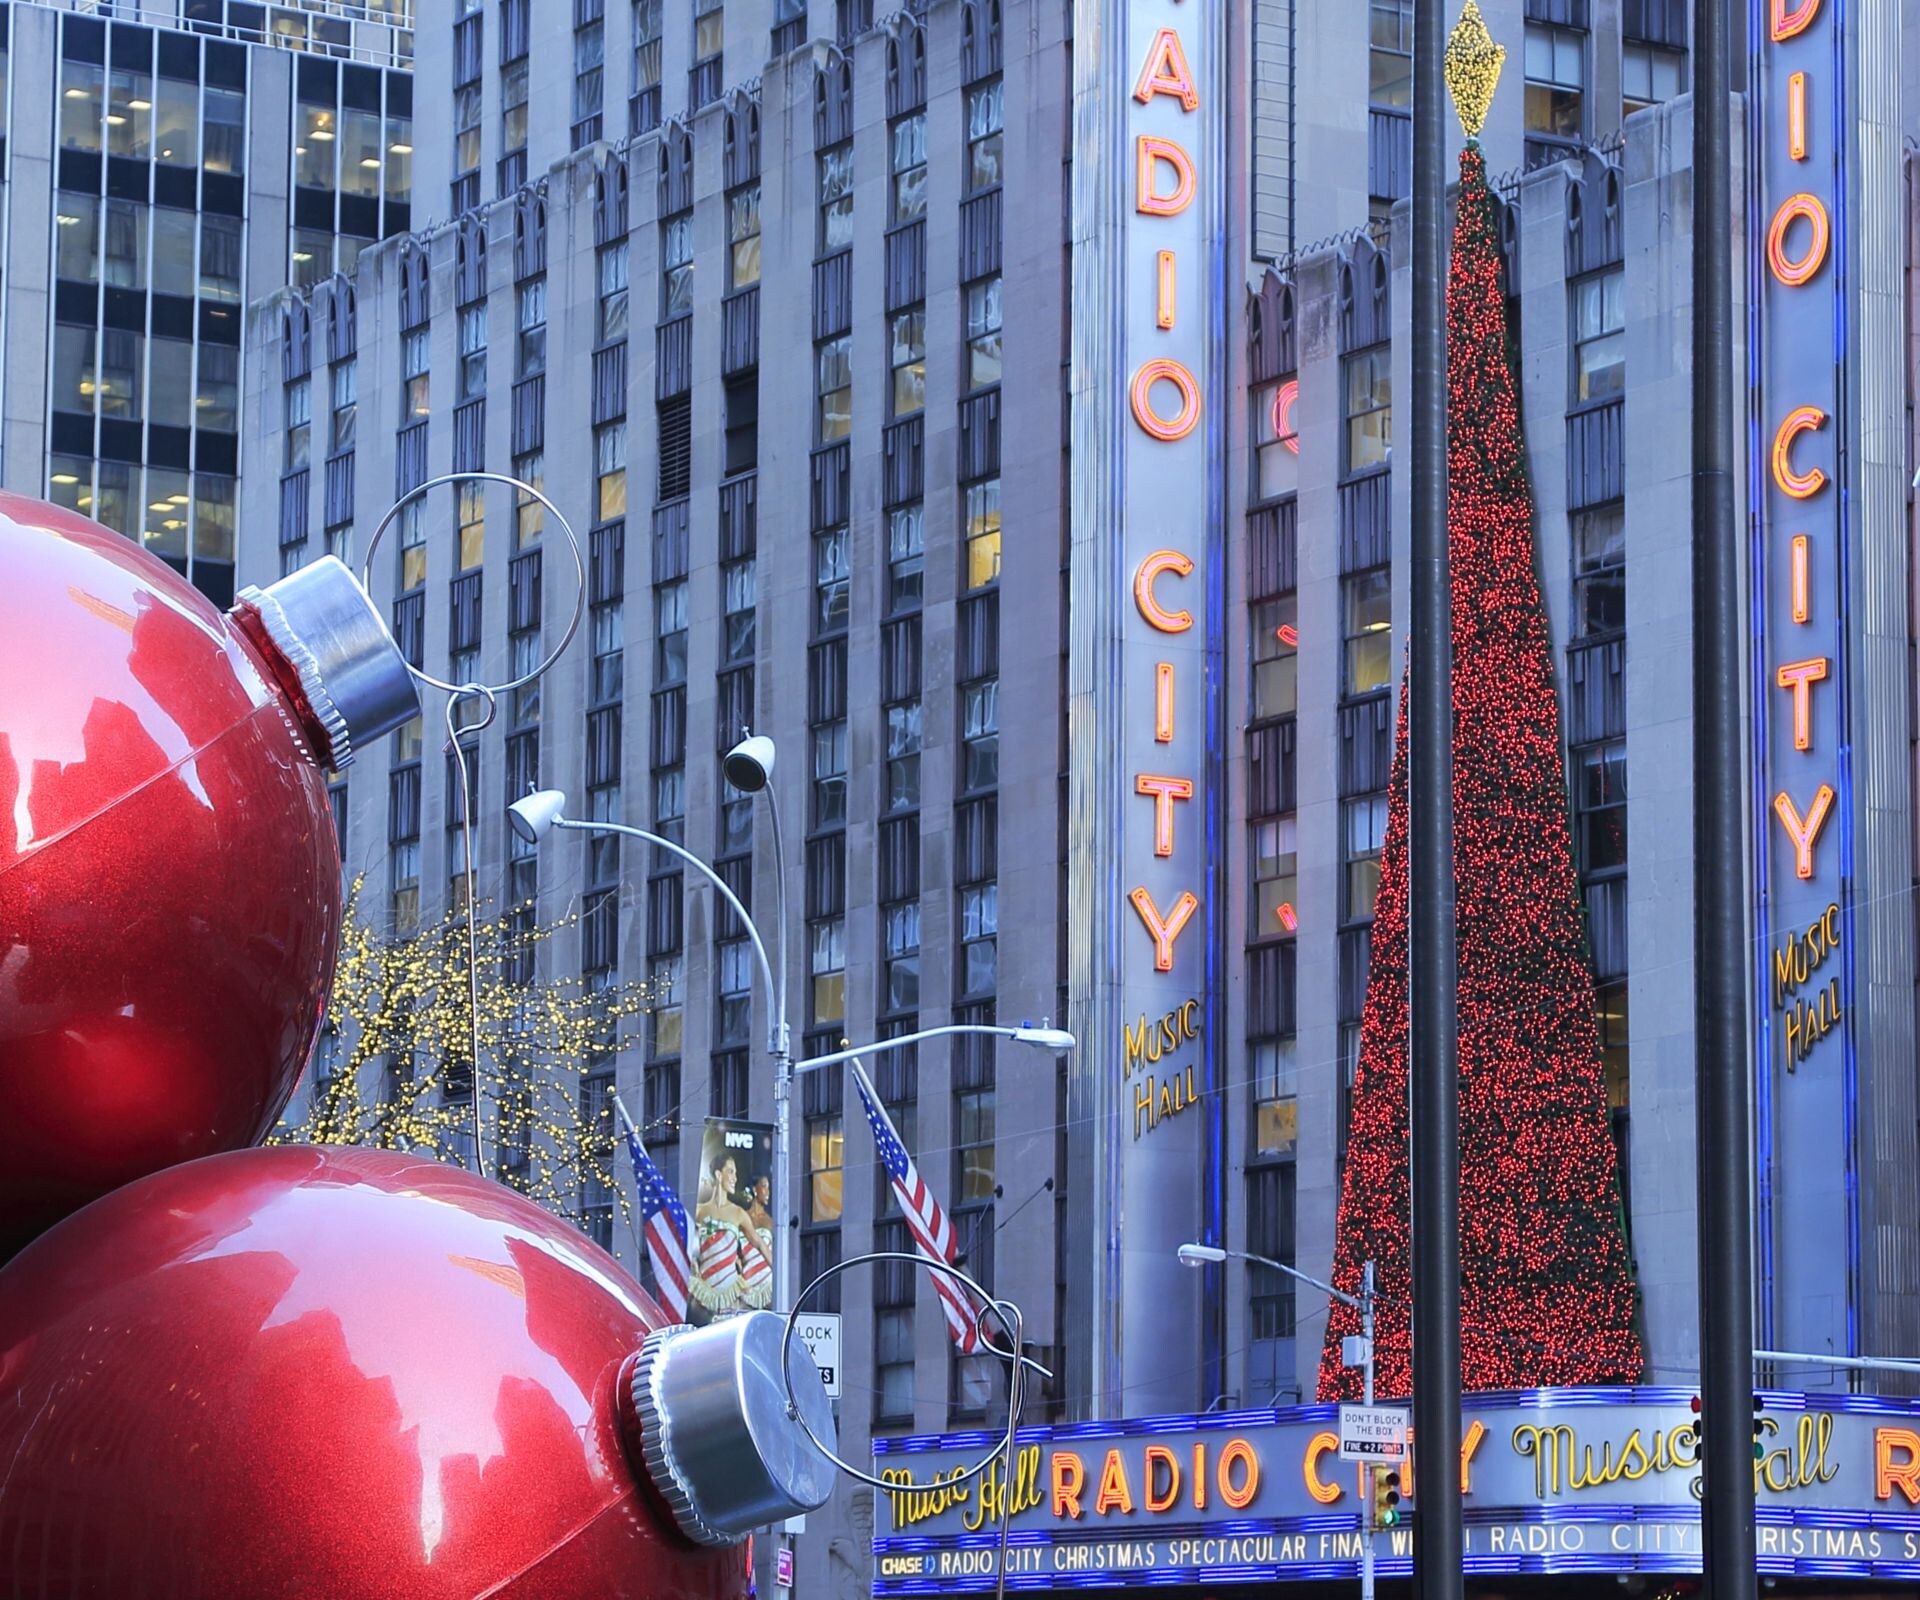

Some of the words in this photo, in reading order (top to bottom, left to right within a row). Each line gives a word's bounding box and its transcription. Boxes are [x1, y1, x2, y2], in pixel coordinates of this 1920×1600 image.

[1130, 0, 1201, 442] ADIO
[1771, 406, 1834, 879] CITY
[1128, 549, 1198, 972] CITY
[725, 1131, 753, 1149] NYC
[794, 1326, 832, 1340] LOCK
[1345, 1413, 1371, 1424] DON'T
[1374, 1415, 1403, 1425] BLOCK
[1356, 1425, 1373, 1435] THE
[1376, 1427, 1393, 1436] BOX
[1346, 1441, 1361, 1451] FINE
[1377, 1443, 1402, 1454] POINTS
[881, 1465, 969, 1531] Music
[963, 1443, 1042, 1532] Hall
[1051, 1437, 1259, 1518] RADIO
[1512, 1423, 1698, 1499] Music
[881, 1556, 924, 1575] CHASE
[941, 1550, 993, 1575] RADIO
[1005, 1548, 1043, 1572] CITY
[1054, 1542, 1156, 1570] CHRISTMAS
[1168, 1535, 1306, 1565] SPECTACULAR
[1320, 1532, 1376, 1559] FINA
[1491, 1525, 1584, 1552] RADIO
[1611, 1524, 1689, 1550] CITY
[1762, 1527, 1882, 1558] RISTMAS
